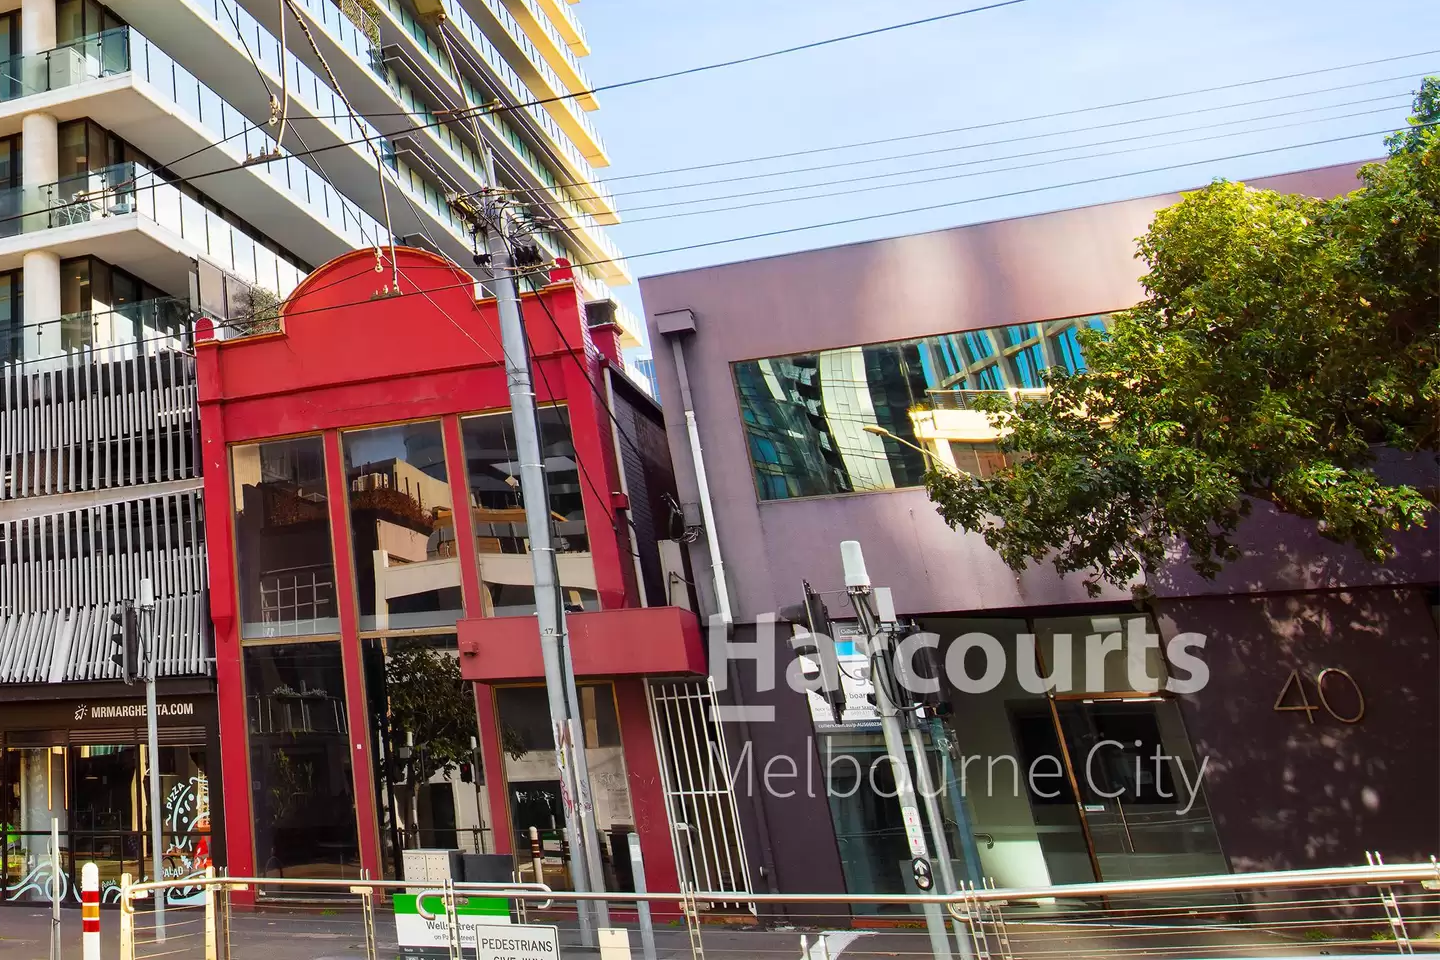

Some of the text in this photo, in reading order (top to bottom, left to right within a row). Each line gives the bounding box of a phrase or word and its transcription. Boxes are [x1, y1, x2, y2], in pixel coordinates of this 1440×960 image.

[1274, 668, 1365, 723] 40
[91, 703, 194, 718] MRMARGHETA.COM
[166, 782, 186, 810] PIZZA
[162, 866, 184, 878] ALAD
[481, 938, 553, 952] PEDESTRIANS
